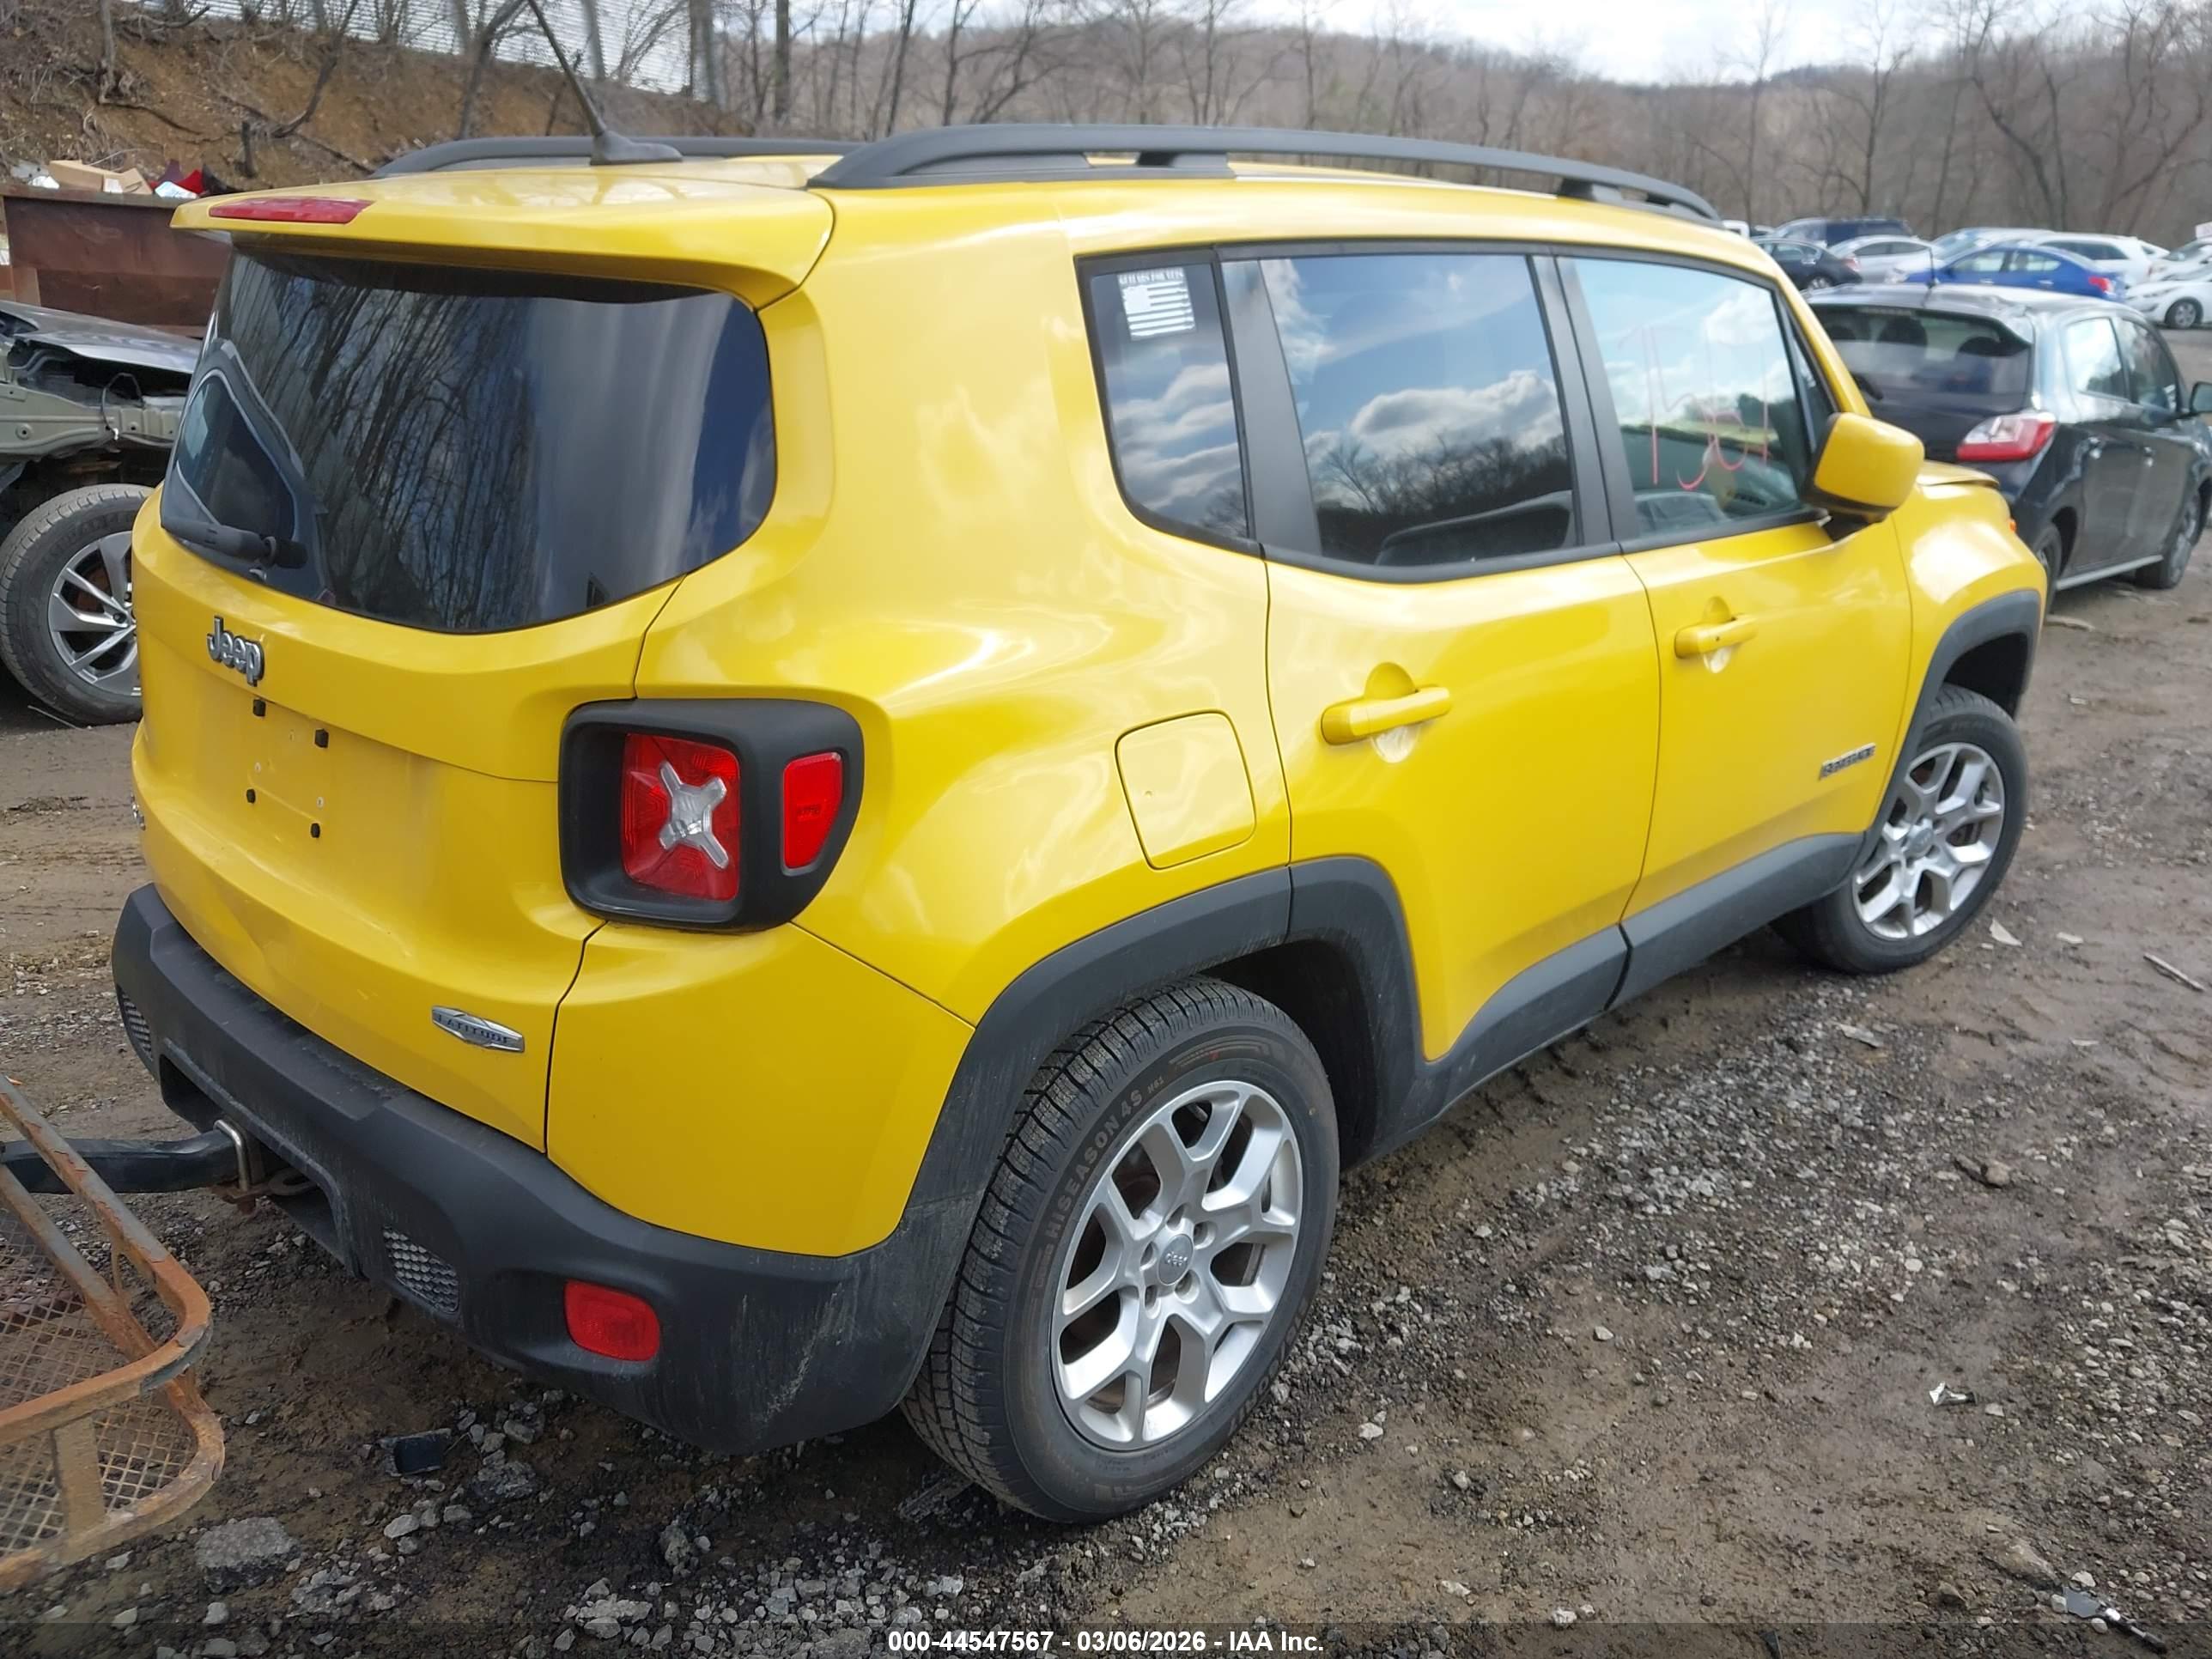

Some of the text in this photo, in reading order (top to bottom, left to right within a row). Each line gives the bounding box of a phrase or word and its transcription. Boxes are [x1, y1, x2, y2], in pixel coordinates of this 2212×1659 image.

[207, 616, 264, 687] Jeep
[437, 1014, 507, 1044] LATITUDE
[1045, 1119, 1121, 1238] HISEASON
[1121, 1090, 1143, 1118] 4S
